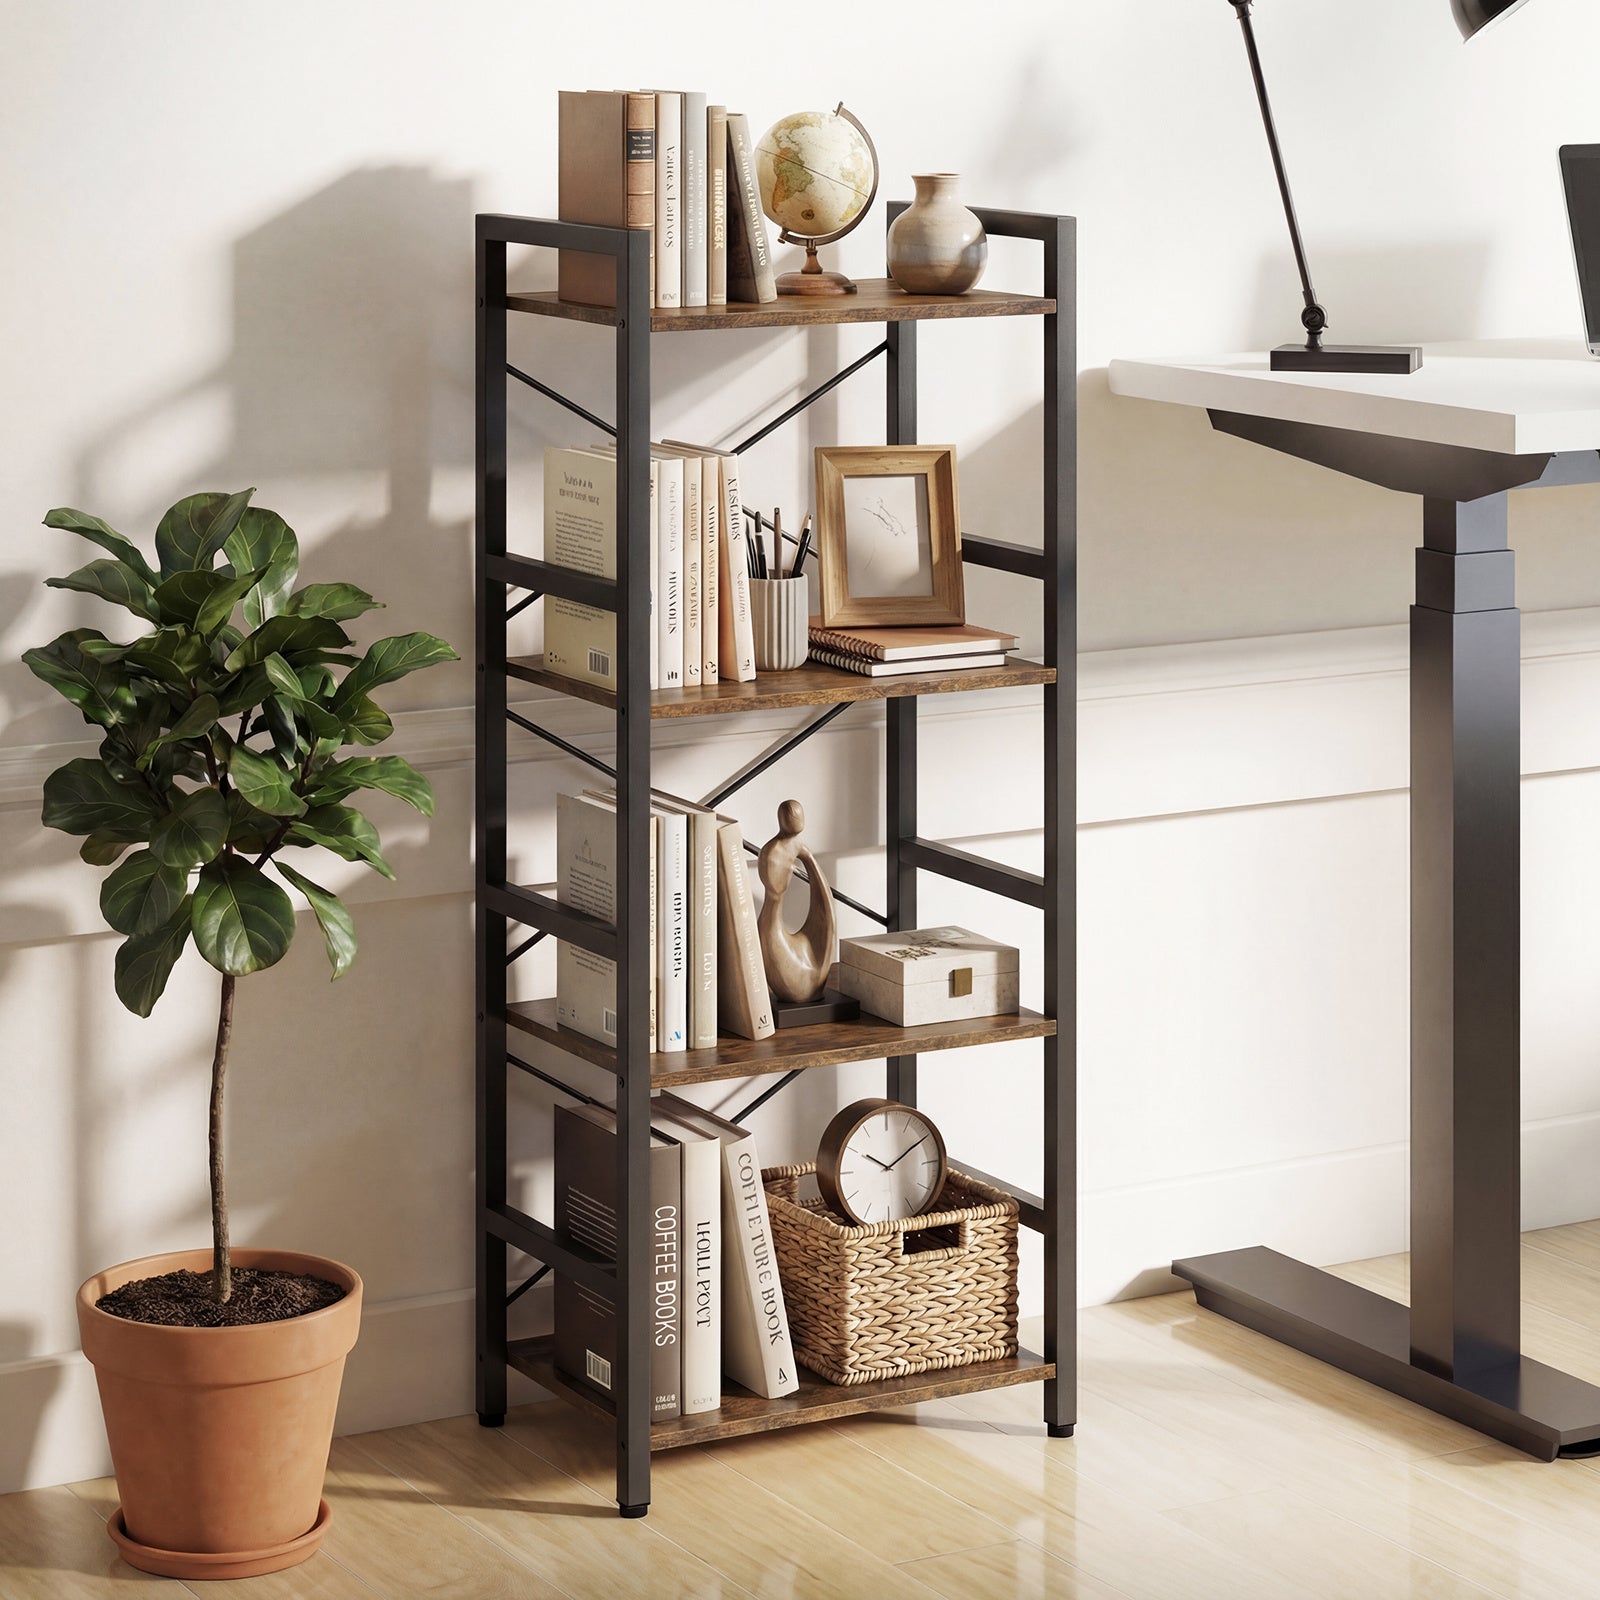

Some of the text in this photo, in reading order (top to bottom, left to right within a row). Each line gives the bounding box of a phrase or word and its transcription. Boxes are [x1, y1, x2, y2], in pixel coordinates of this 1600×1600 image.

[655, 1205, 677, 1347] COFFEE BOOKS
[761, 1287, 784, 1346] BOOK
